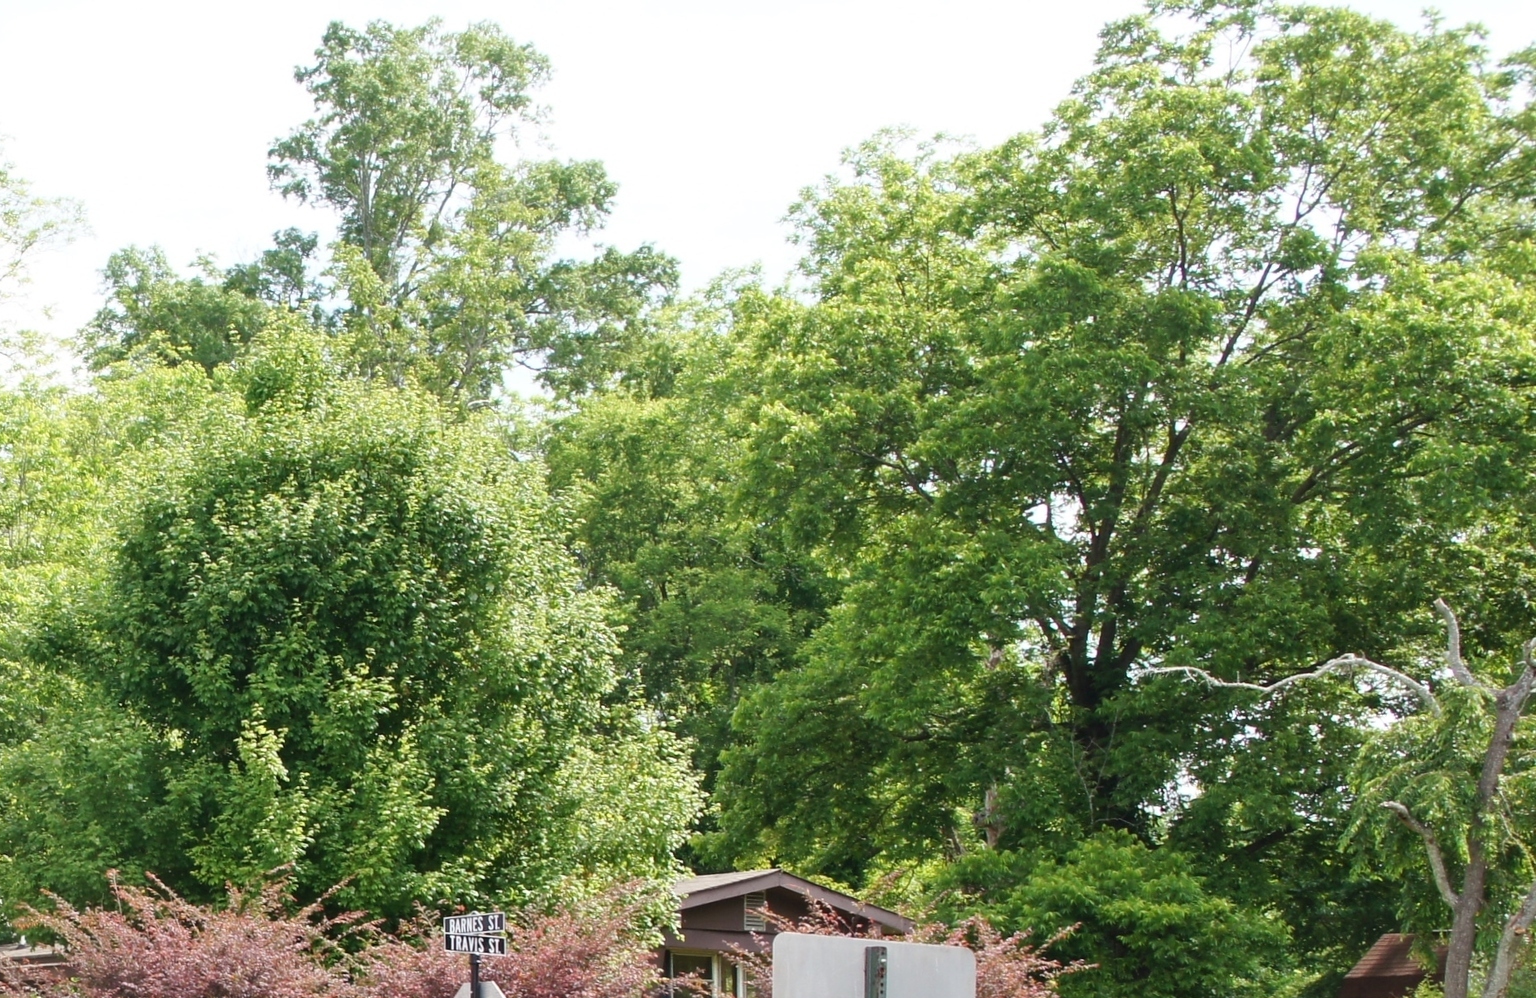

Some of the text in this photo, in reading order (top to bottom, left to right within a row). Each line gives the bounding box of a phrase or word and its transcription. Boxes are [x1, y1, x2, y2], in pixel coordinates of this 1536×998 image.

[449, 915, 500, 933] BARNES ST.
[449, 935, 501, 953] TRAVIS ST.
